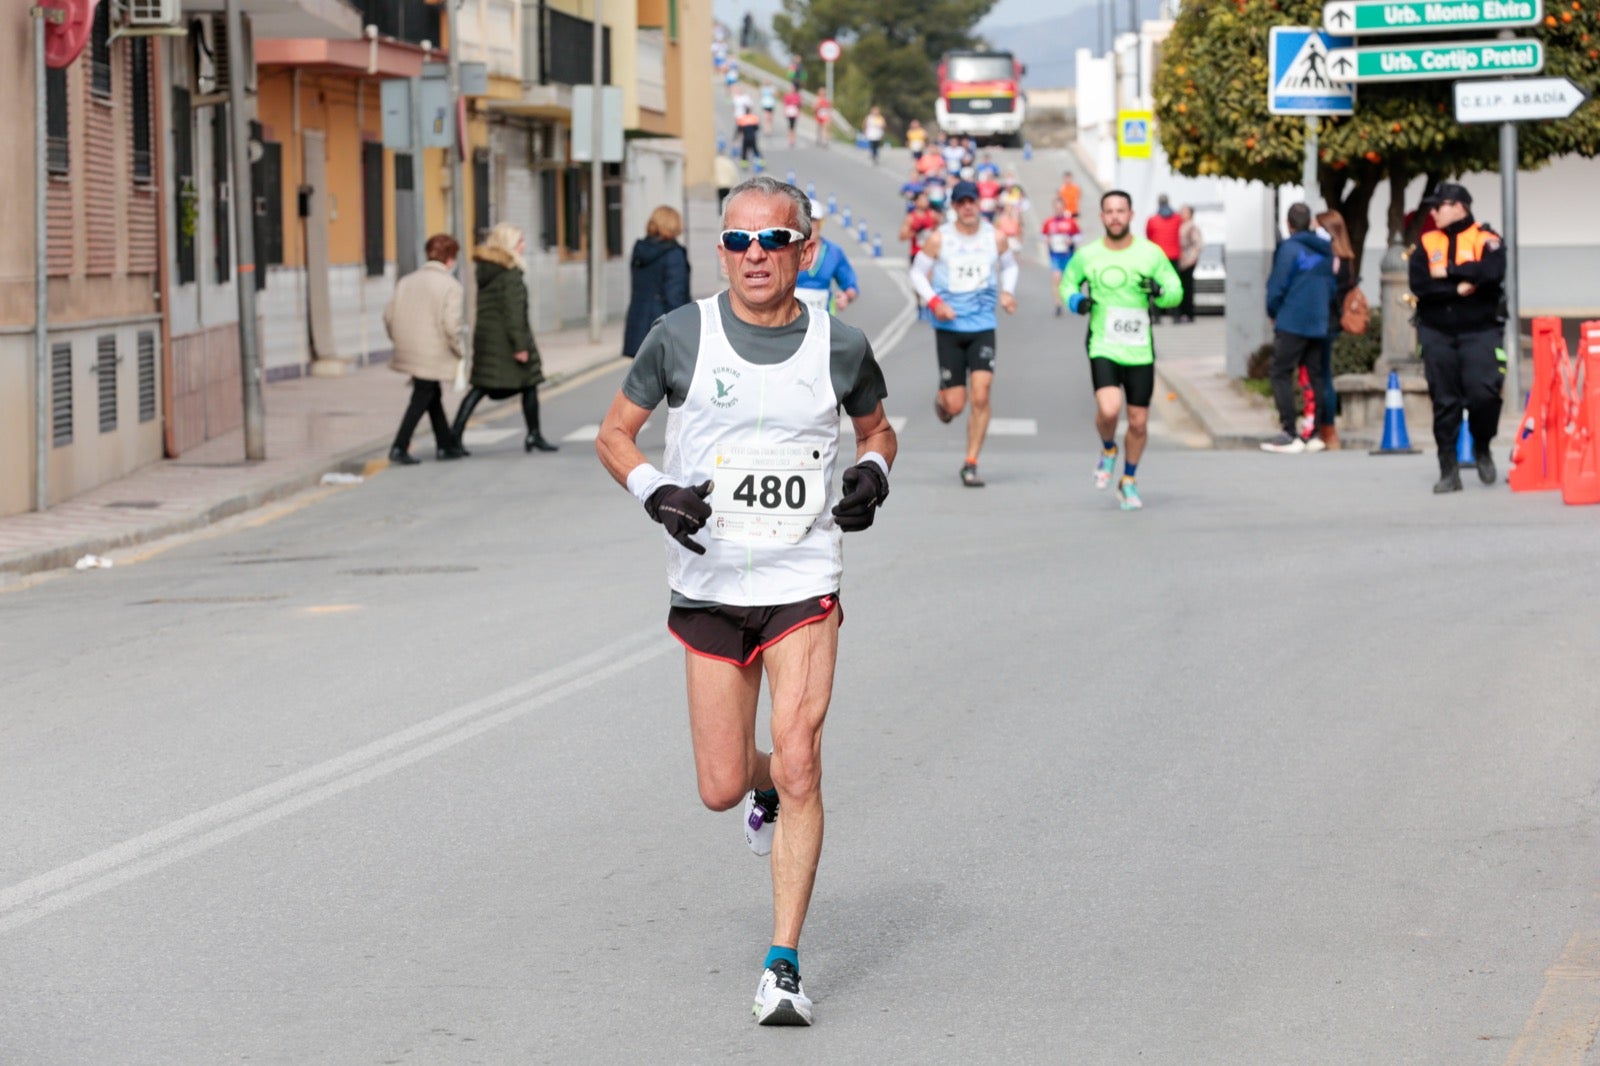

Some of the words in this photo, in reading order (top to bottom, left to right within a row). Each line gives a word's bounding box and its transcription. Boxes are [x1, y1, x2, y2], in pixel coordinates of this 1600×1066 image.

[1383, 6, 1421, 24] Urb.
[1424, 3, 1480, 22] Monte
[1483, 0, 1531, 19] Elvira
[1380, 52, 1418, 72] Urb.
[1421, 50, 1479, 72] Cortijo
[1482, 46, 1534, 67] Pretel
[957, 266, 981, 279] 741
[1113, 319, 1142, 333] 662
[712, 367, 741, 378] RUNNING
[733, 474, 806, 510] 480
